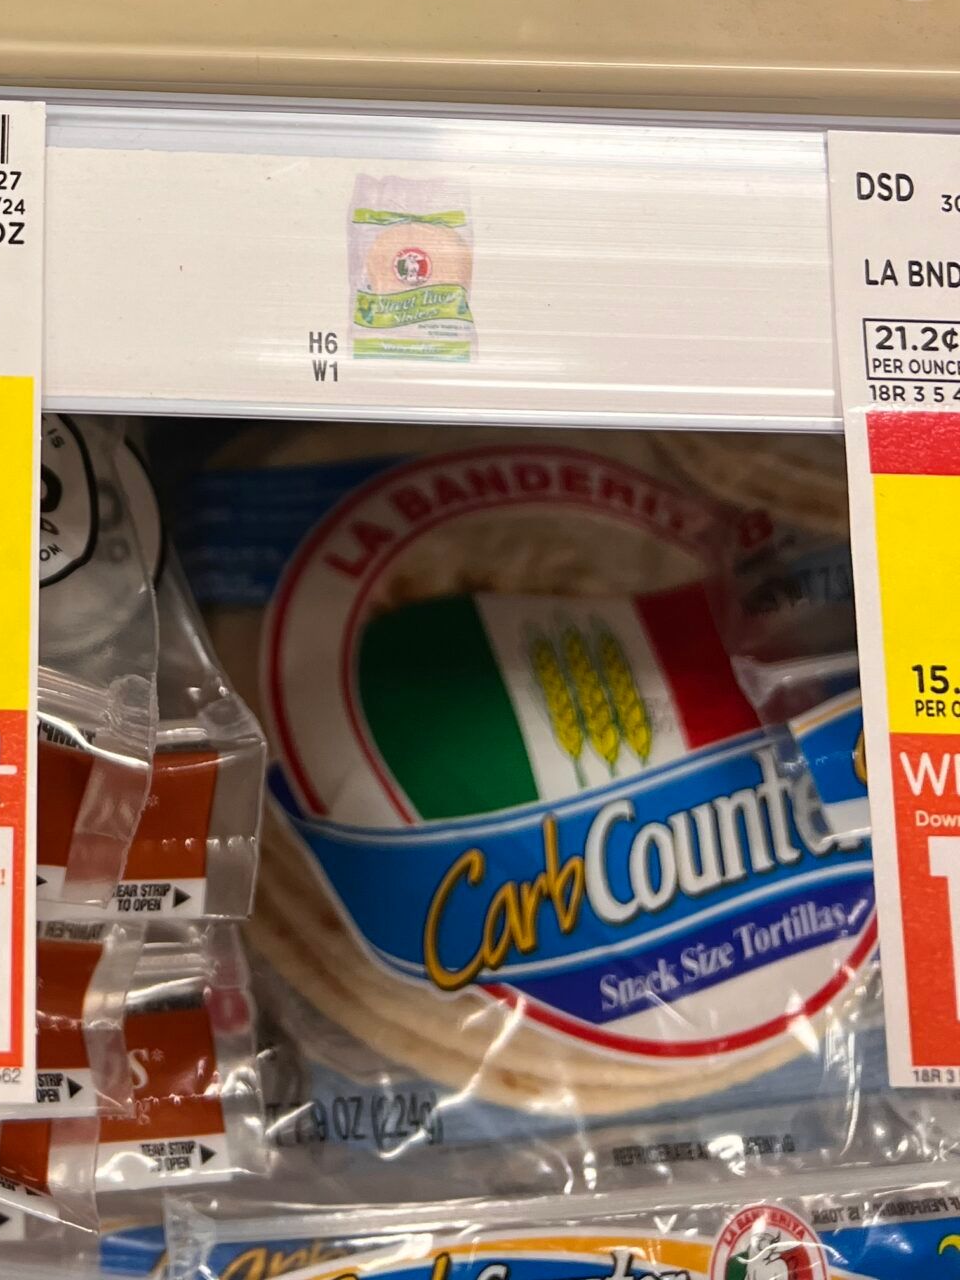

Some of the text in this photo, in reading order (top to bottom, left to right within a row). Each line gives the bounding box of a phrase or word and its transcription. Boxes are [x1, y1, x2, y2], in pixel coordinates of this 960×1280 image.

[855, 171, 915, 203] DSD
[864, 258, 960, 288] LA BND
[308, 331, 339, 355] H6
[875, 325, 960, 353] 21.2¢
[312, 359, 340, 382] W1
[872, 358, 904, 375] PER
[868, 384, 906, 402] 18R
[913, 386, 925, 402] 3
[933, 386, 945, 403] 5
[323, 521, 397, 580] LA
[390, 462, 700, 532] BANDERI
[915, 700, 946, 718] PER
[140, 883, 172, 898] STRIP
[117, 898, 162, 912] TO OPEN
[598, 958, 681, 1012] Snack
[680, 942, 735, 984] Size
